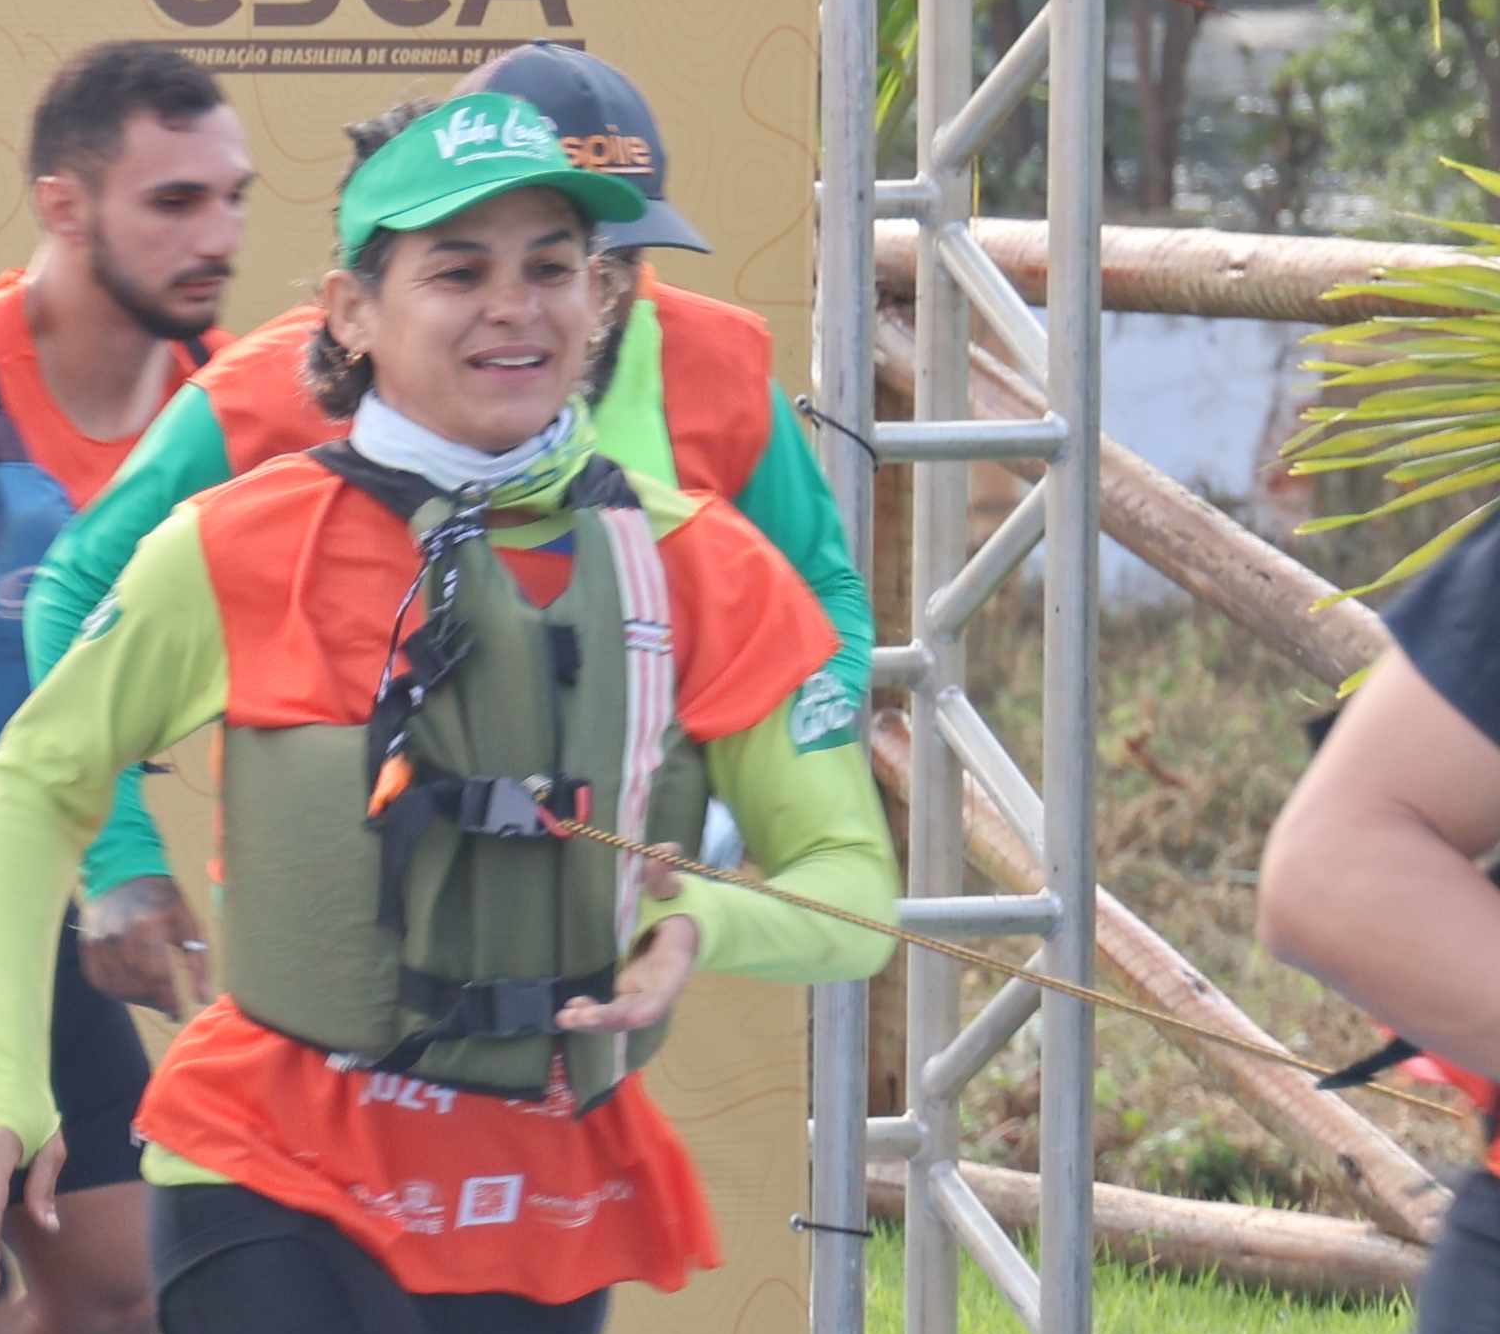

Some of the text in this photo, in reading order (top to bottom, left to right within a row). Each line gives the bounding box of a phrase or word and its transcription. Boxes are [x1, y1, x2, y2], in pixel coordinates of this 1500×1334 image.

[270, 47, 362, 65] BRASILEIRA
[366, 48, 388, 65] DE
[390, 48, 458, 65] CORRIDA
[462, 48, 482, 65] DE
